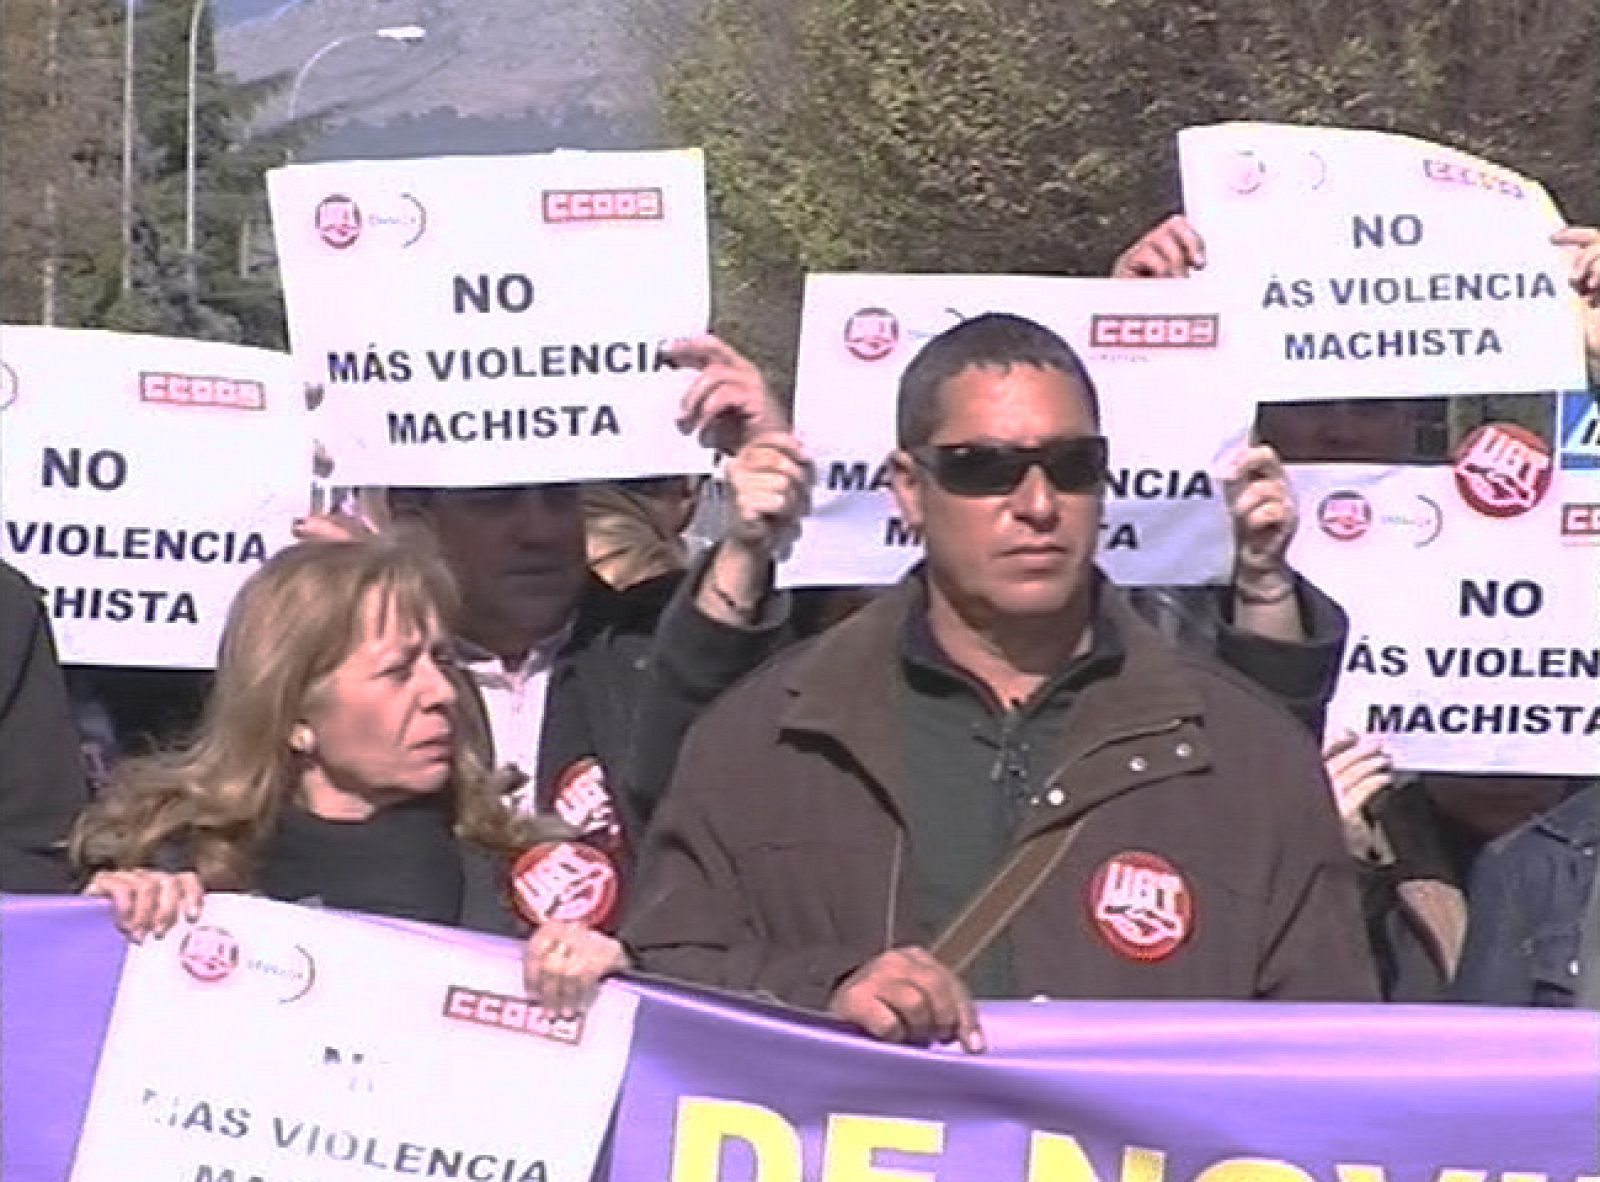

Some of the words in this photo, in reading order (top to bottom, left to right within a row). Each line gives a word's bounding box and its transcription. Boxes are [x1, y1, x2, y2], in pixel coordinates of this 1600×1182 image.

[1353, 214, 1423, 248] NO
[454, 273, 534, 313] NO
[1262, 275, 1315, 309] ÁS
[1329, 272, 1557, 306] VIOLENCIA
[326, 342, 412, 383] MÁS
[1284, 328, 1503, 361] MACHISTA
[386, 405, 621, 444] MACHISTA
[41, 447, 128, 490] NO
[827, 458, 893, 491] MA
[6, 521, 266, 563] VIOLENCIA
[53, 586, 198, 624] HISTA
[1459, 579, 1543, 618] NO
[1347, 634, 1409, 677] ÁS
[1425, 646, 1600, 678] VIOLEN
[272, 1117, 550, 1182] VIOLENCIA
